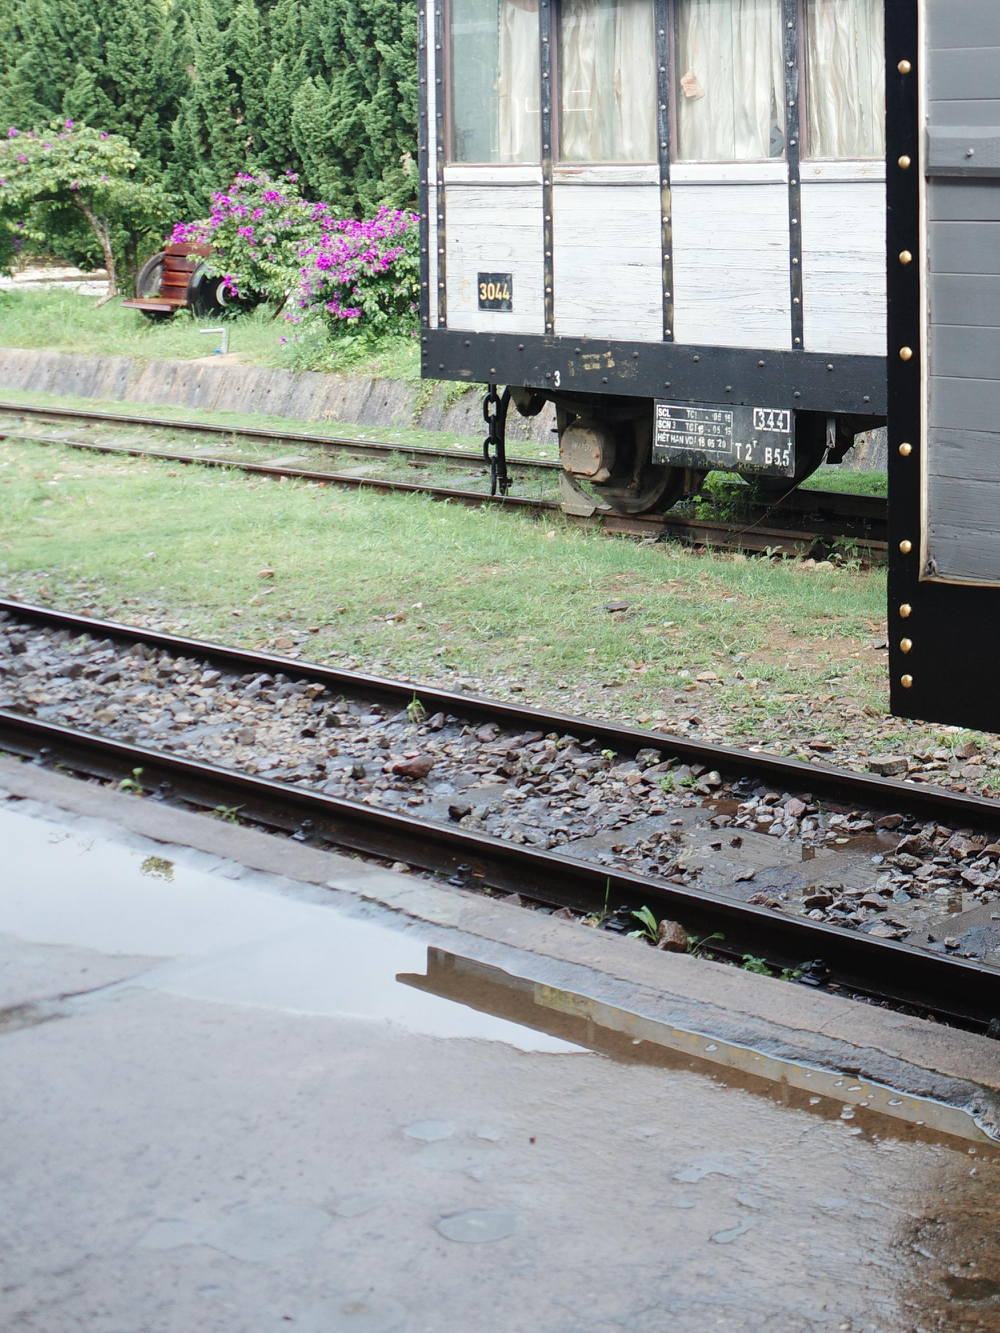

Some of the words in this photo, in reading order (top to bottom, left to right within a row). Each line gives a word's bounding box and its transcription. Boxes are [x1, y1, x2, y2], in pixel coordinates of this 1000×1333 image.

[479, 282, 510, 301] 3044
[554, 370, 561, 387] 3
[758, 410, 784, 429] 344
